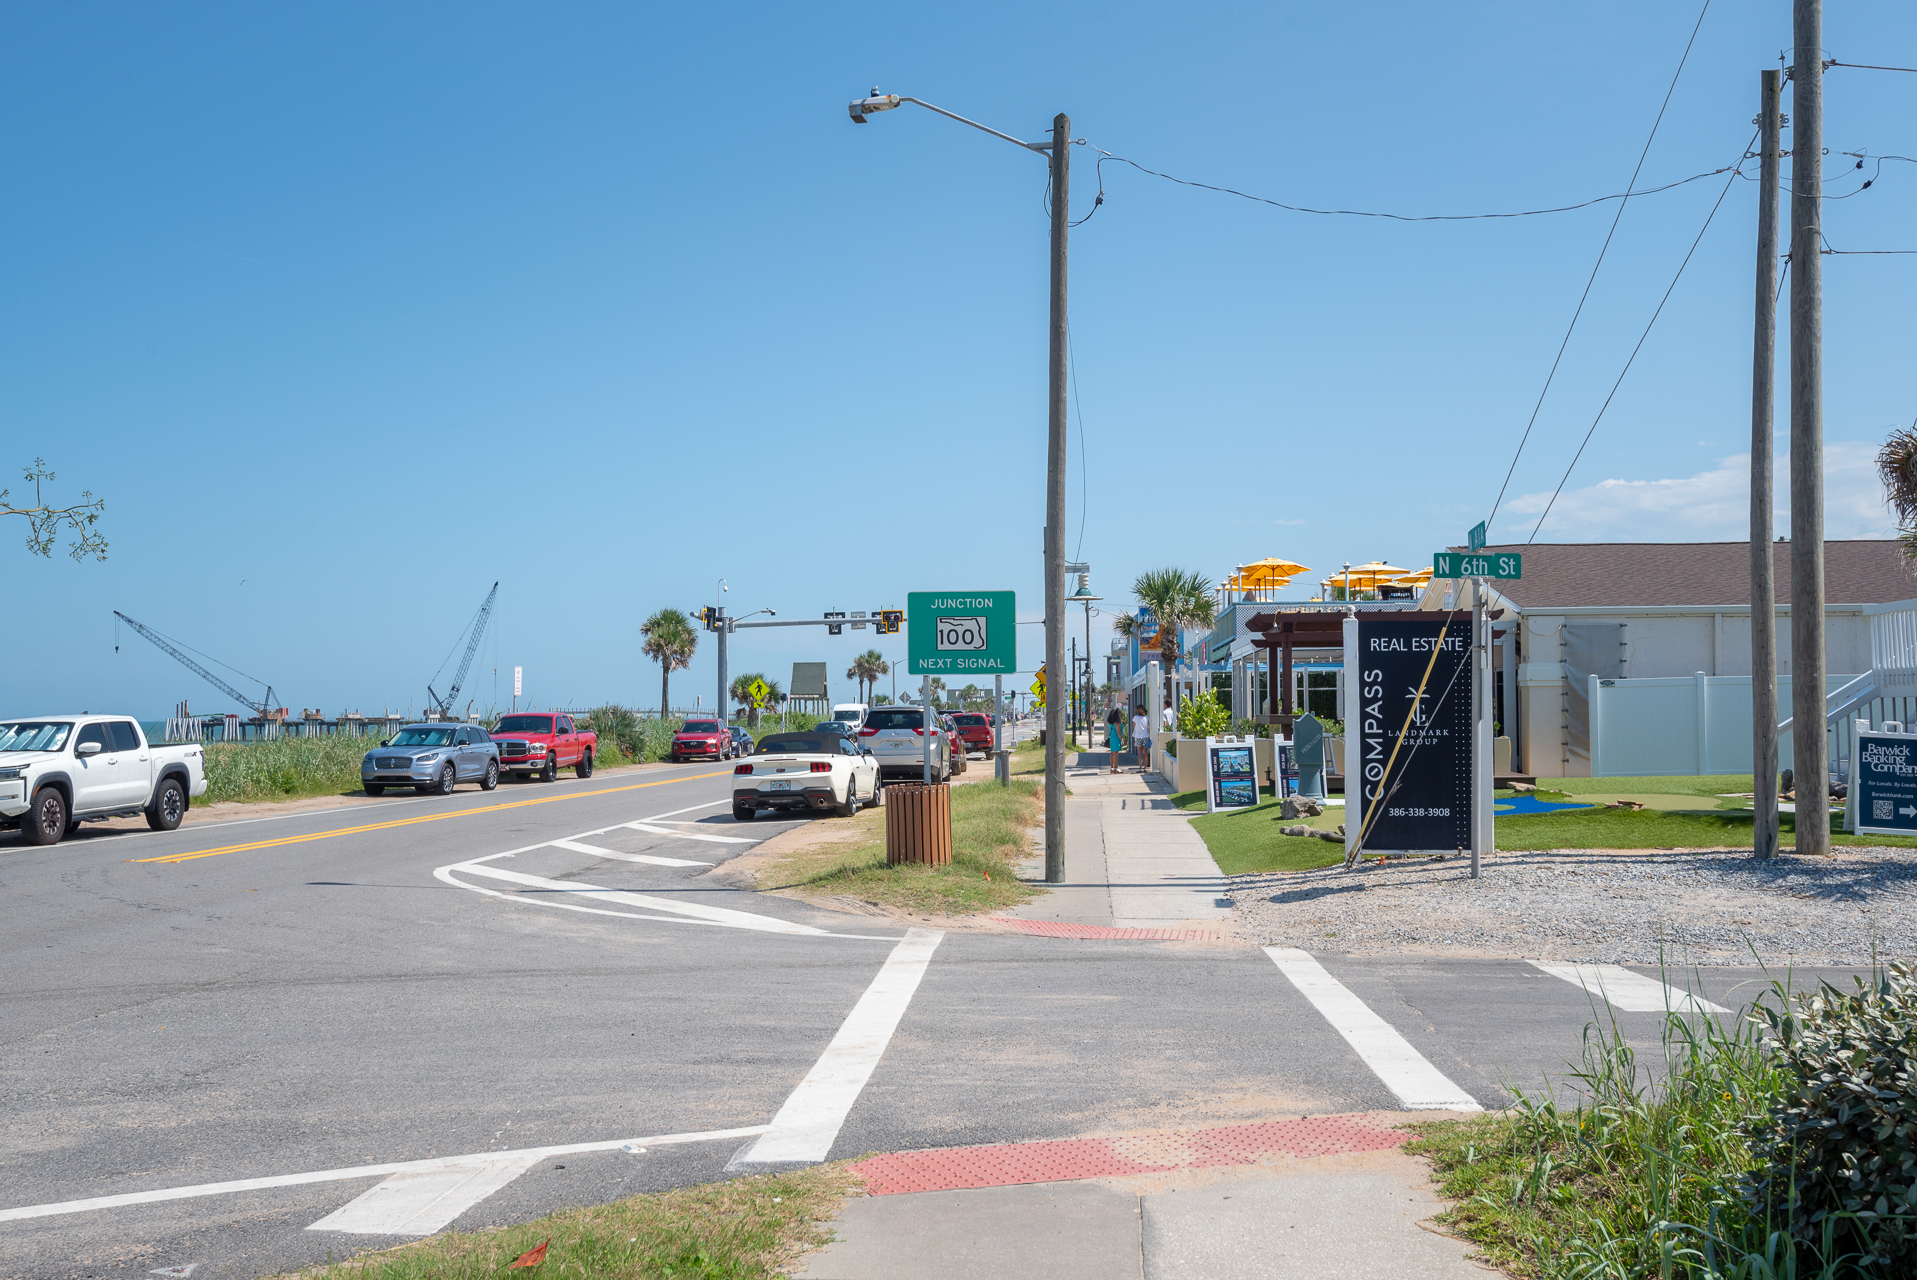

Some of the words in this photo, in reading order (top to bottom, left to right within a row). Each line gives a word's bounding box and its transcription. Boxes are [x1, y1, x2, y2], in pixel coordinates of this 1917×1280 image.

[1439, 556, 1450, 574] N
[1461, 557, 1488, 575] 6th
[1498, 557, 1516, 575] St
[930, 598, 993, 609] JUNCTION
[939, 628, 975, 645] 100
[1370, 637, 1408, 652] REAL
[1412, 637, 1464, 651] ESTATE
[919, 658, 952, 669] NEXT
[957, 658, 1005, 668] SIGNAL
[1363, 669, 1385, 801] COMPASS
[1388, 729, 1449, 737] LANDMARK
[1868, 743, 1910, 756] Barwick
[1862, 752, 1906, 766] Banking
[1871, 761, 1917, 776] Compan
[1388, 807, 1451, 817] 386-338-3908
